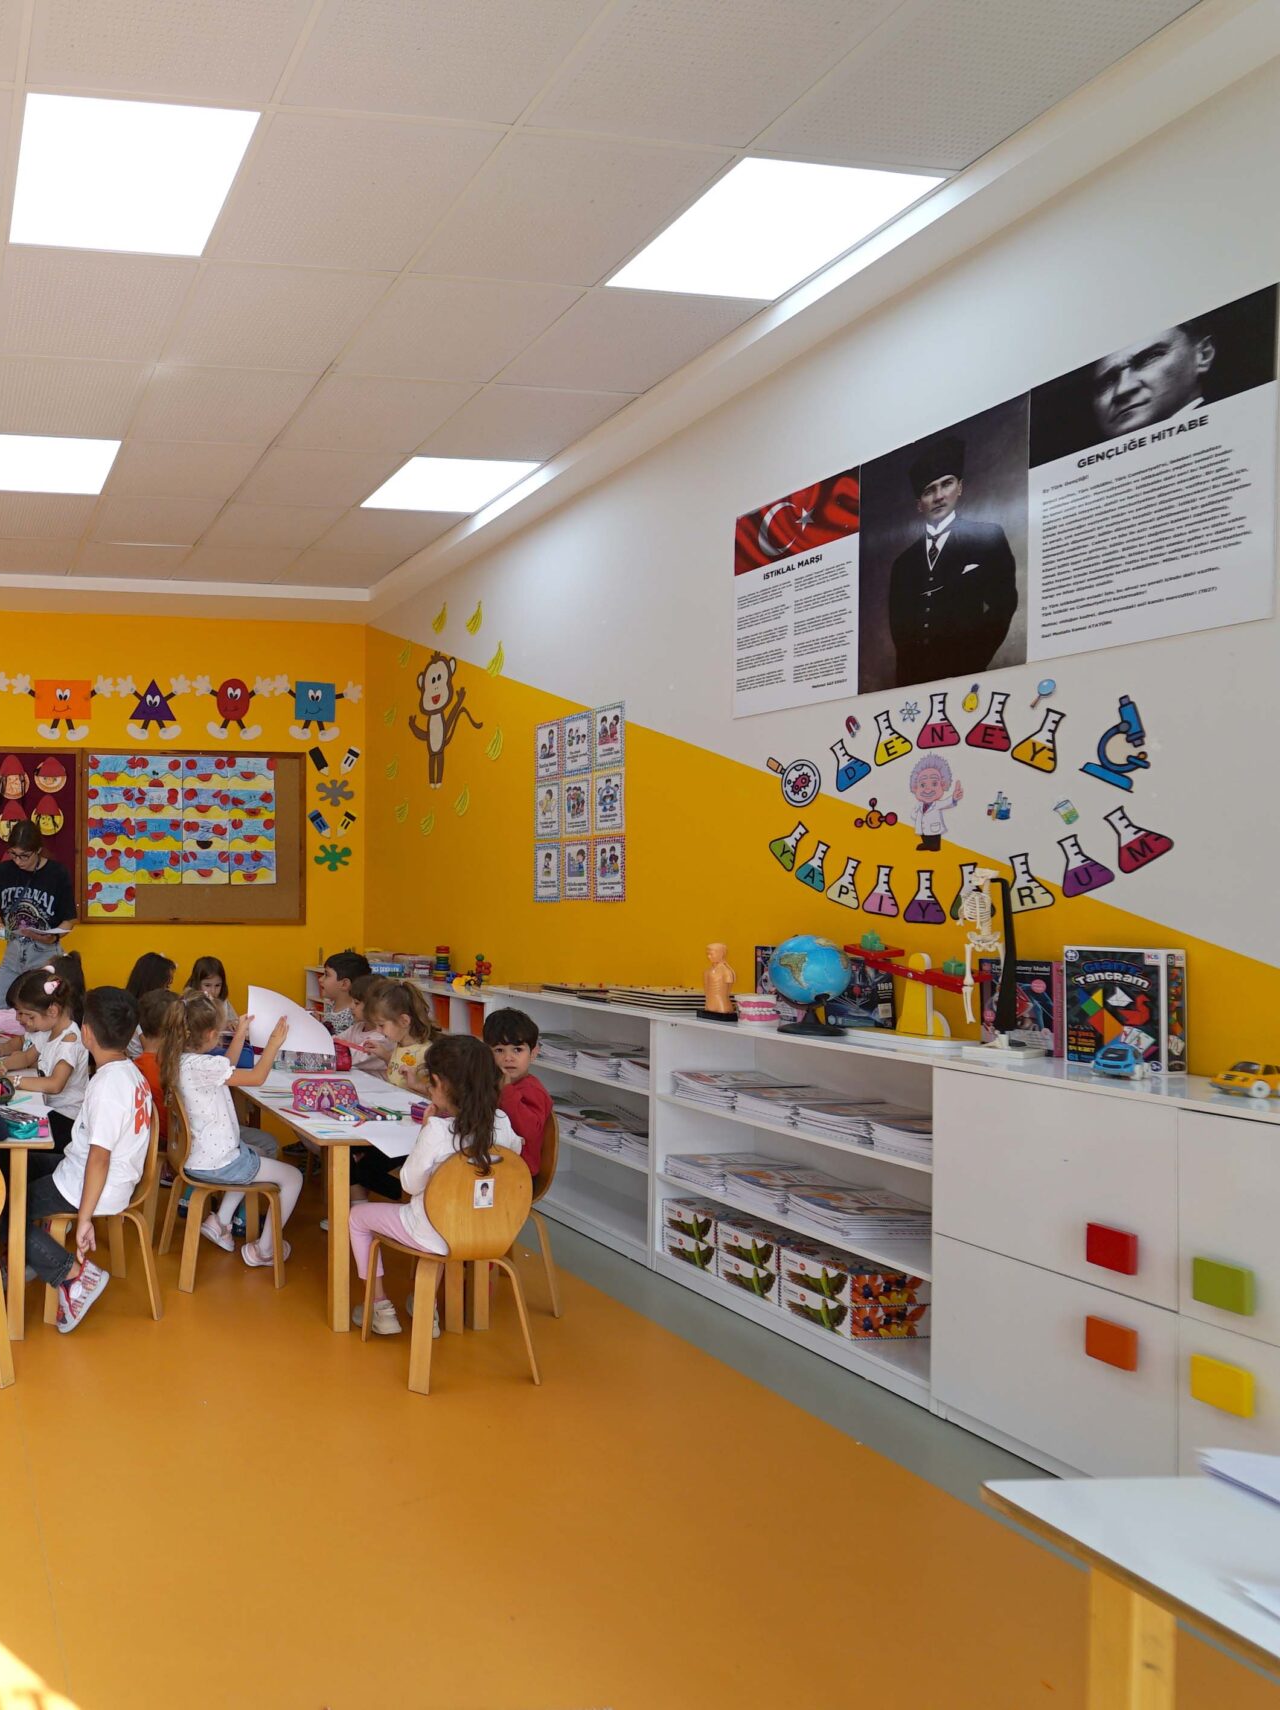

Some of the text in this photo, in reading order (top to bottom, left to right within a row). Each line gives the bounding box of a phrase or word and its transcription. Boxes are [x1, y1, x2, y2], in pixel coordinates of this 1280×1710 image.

[1077, 415, 1209, 468] GENÇLİĞE HİTABE
[798, 554, 823, 567] MARŞI
[843, 725, 1045, 781] DENEY
[779, 834, 1154, 920] YAPIYRUM
